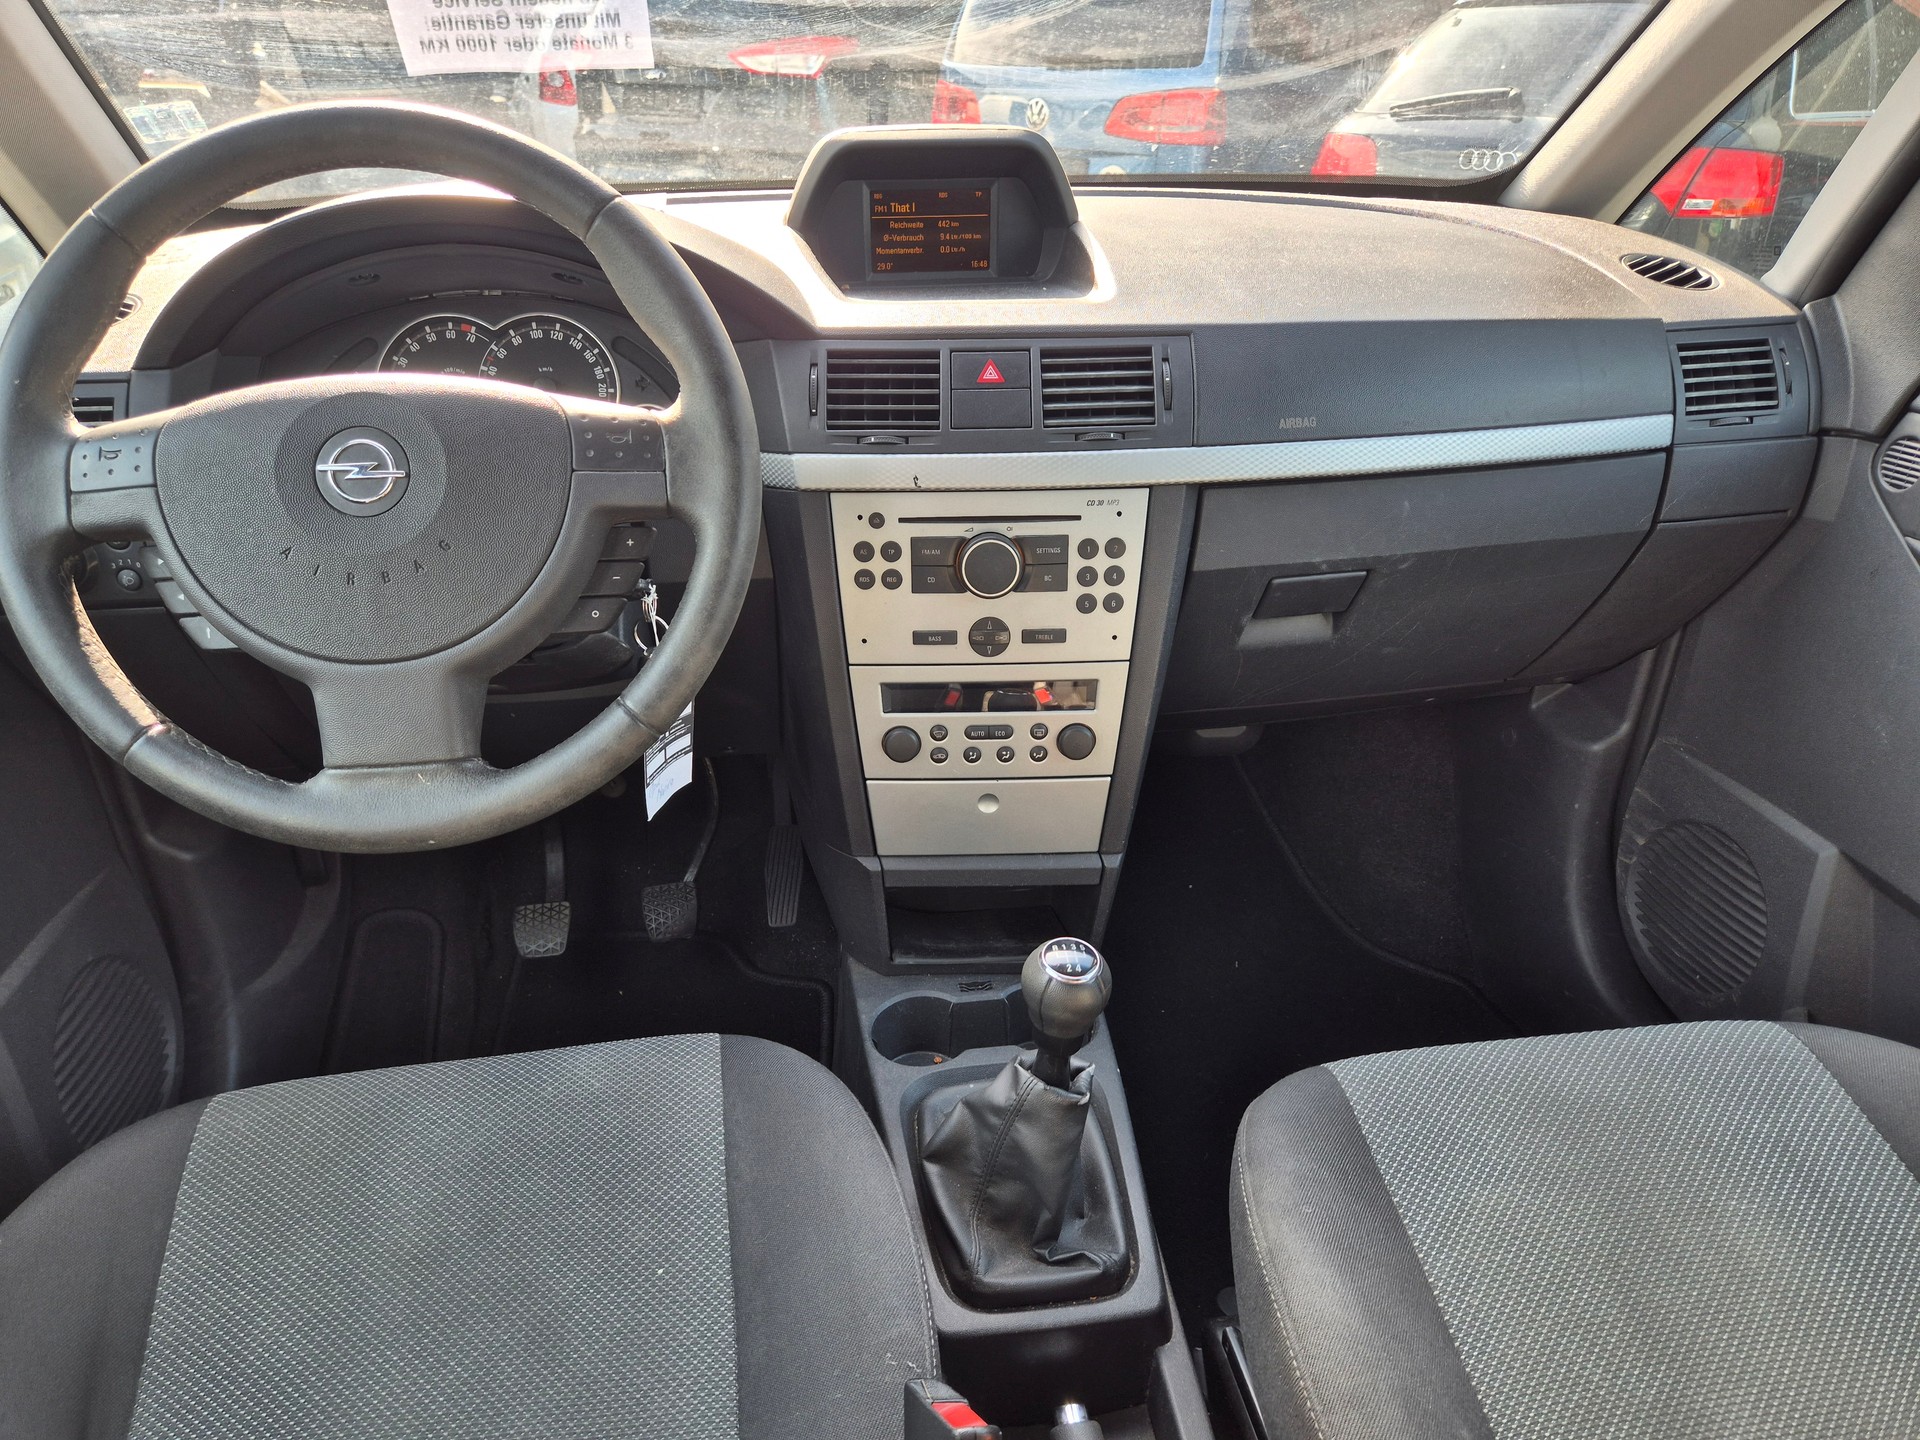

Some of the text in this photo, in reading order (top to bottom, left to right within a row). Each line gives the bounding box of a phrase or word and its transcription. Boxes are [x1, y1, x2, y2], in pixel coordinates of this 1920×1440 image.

[874, 205, 887, 213] FM1
[890, 202, 910, 213] That
[889, 221, 924, 229] Reichweite
[937, 220, 950, 228] 442
[883, 234, 924, 242] Ø-Verbrauch
[940, 245, 950, 253] 0.0
[399, 330, 476, 368] 30 40 50 60 70
[488, 329, 607, 398] 40 60 80 100 120 140 160 180 200
[1279, 416, 1317, 429] AIRBAG
[1086, 499, 1095, 507] CD
[280, 539, 451, 586] AIRBAG
[1085, 573, 1090, 581] 3
[1111, 600, 1116, 608] 6
[1066, 964, 1081, 972] 2 4
